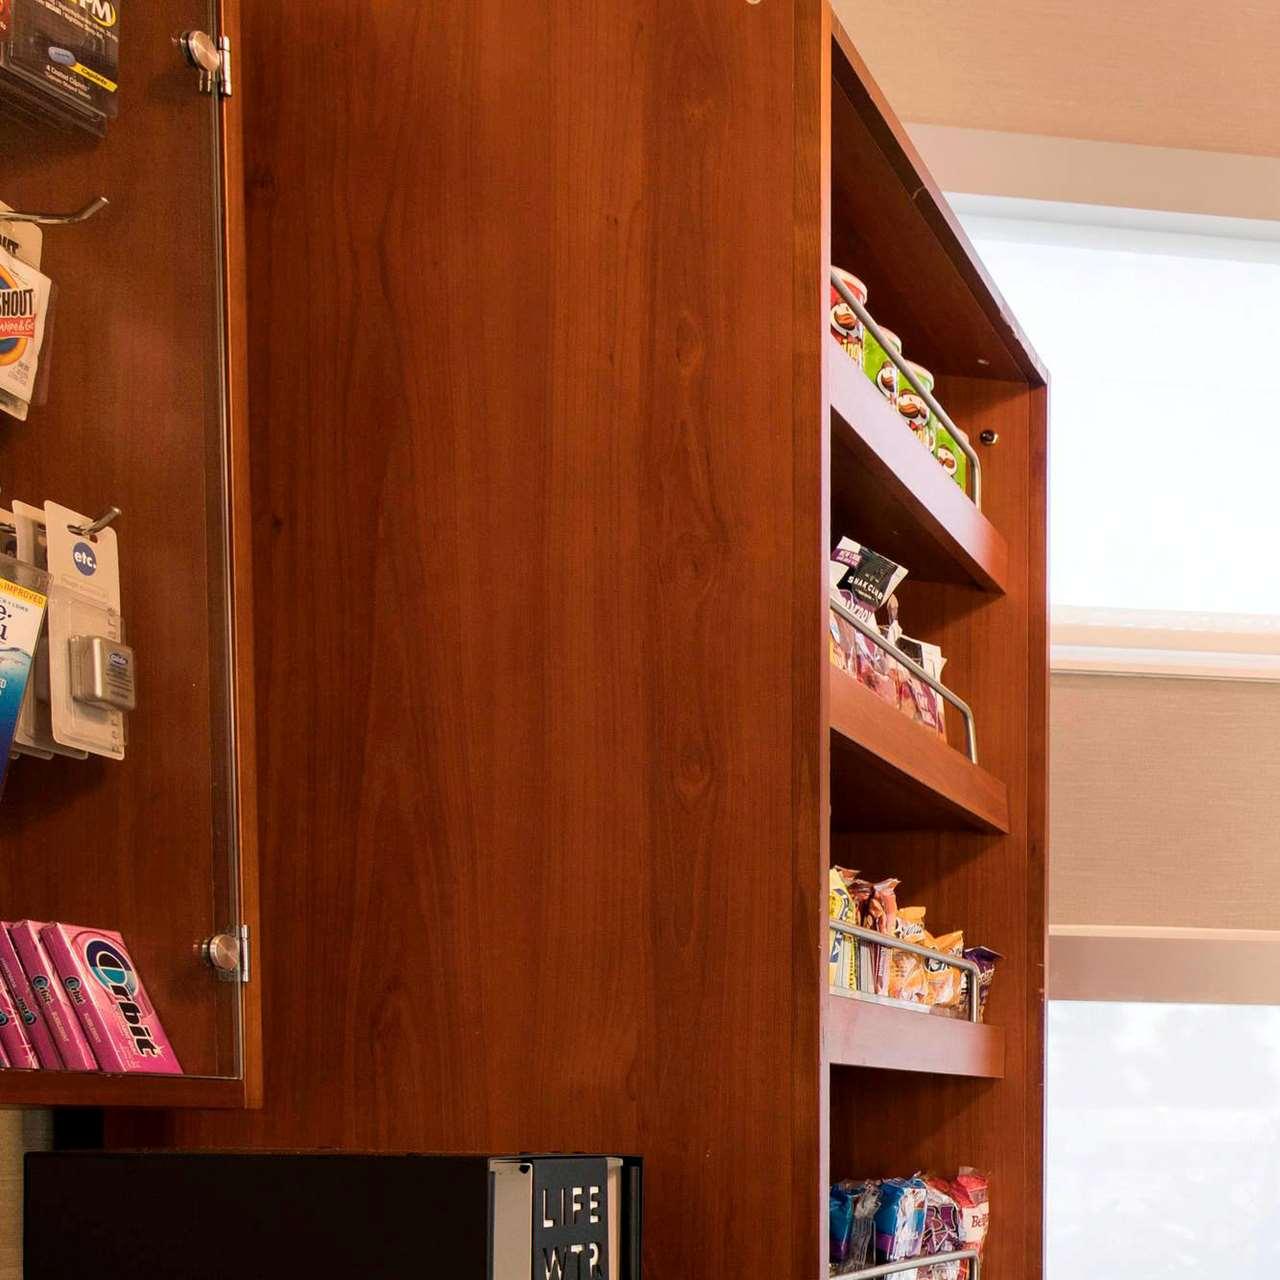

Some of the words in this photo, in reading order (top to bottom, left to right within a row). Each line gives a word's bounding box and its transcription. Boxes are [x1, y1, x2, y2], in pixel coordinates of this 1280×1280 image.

[0, 288, 34, 317] HOUT
[73, 551, 96, 569] etc.
[94, 950, 161, 1057] Orbit
[543, 1185, 601, 1229] LIFE
